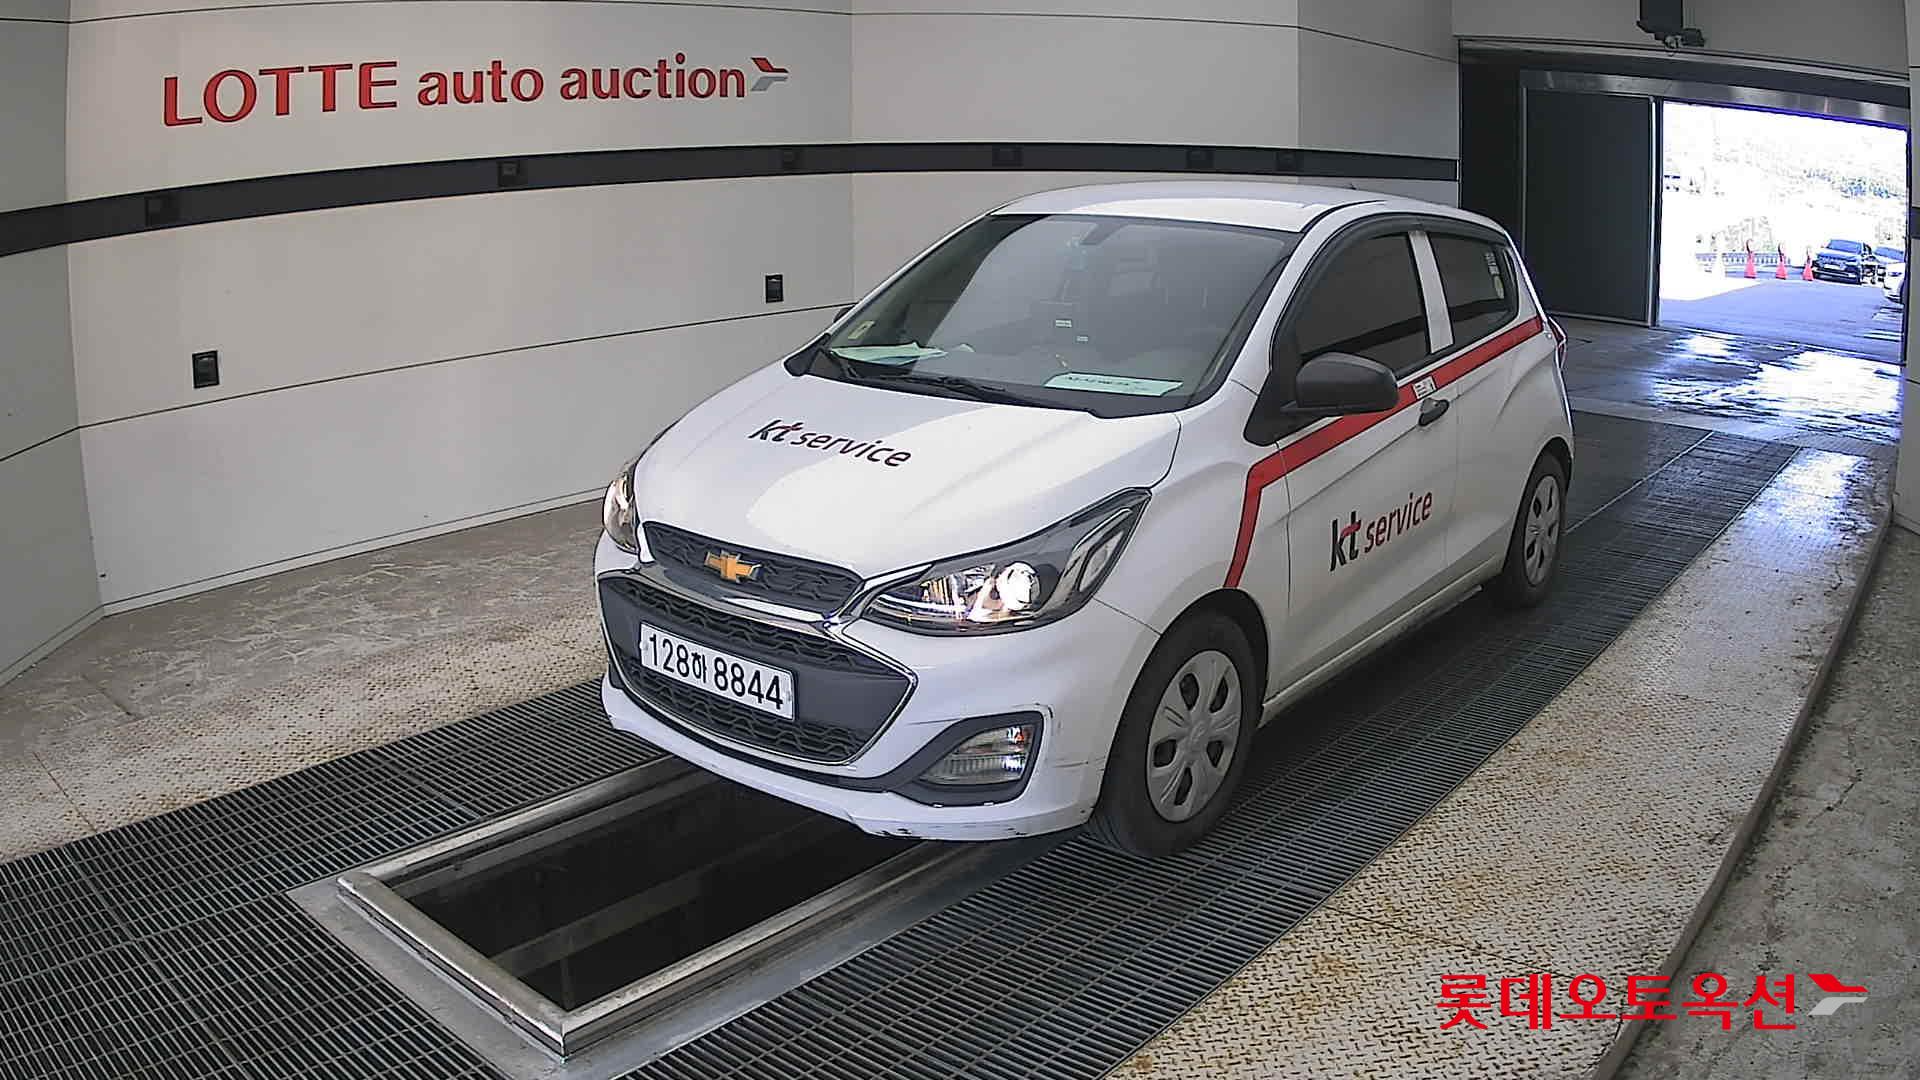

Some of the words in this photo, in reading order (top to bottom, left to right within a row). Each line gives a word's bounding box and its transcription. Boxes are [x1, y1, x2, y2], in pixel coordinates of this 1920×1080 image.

[163, 60, 398, 128] LOTTE
[417, 60, 544, 106] auto
[559, 53, 746, 101] auction
[748, 419, 803, 442] kt
[790, 432, 911, 467] service
[1330, 510, 1361, 572] kt
[1364, 491, 1433, 553] service
[649, 633, 708, 684] 128하
[713, 656, 784, 710] 8844
